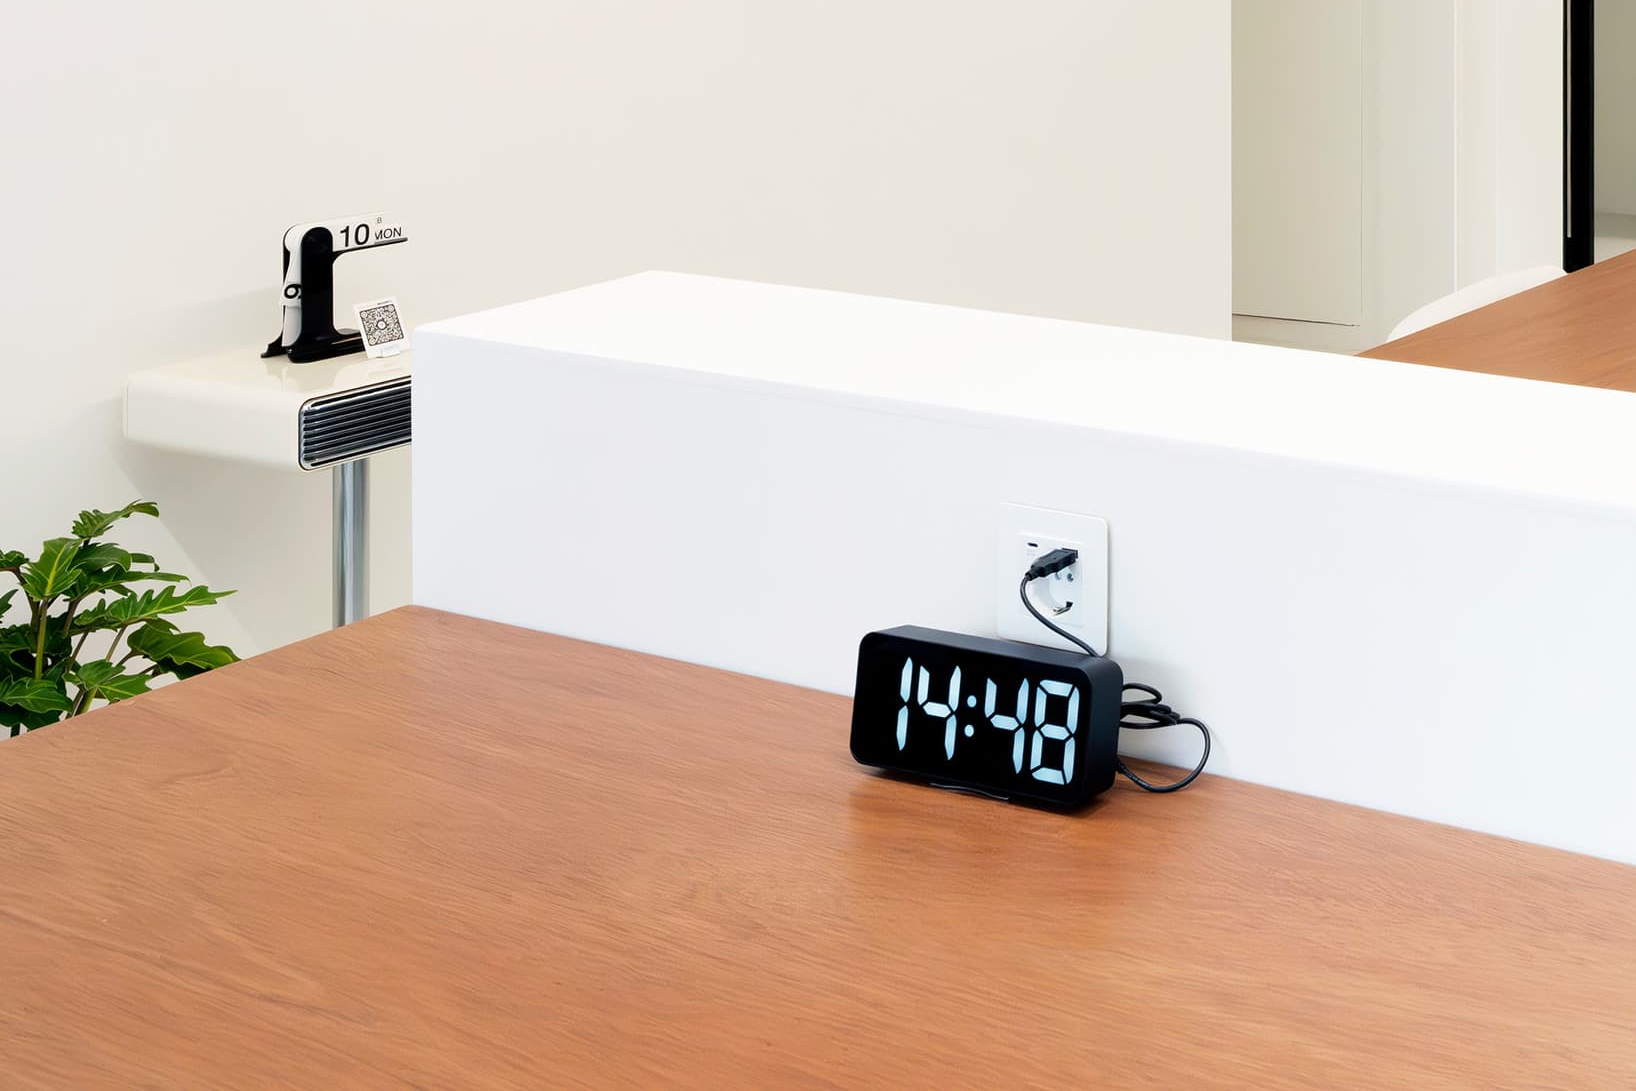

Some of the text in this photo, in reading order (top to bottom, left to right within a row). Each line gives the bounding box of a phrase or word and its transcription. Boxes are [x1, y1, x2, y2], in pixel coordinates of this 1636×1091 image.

[339, 224, 402, 248] 10 MON
[895, 656, 1081, 786] 14:48
